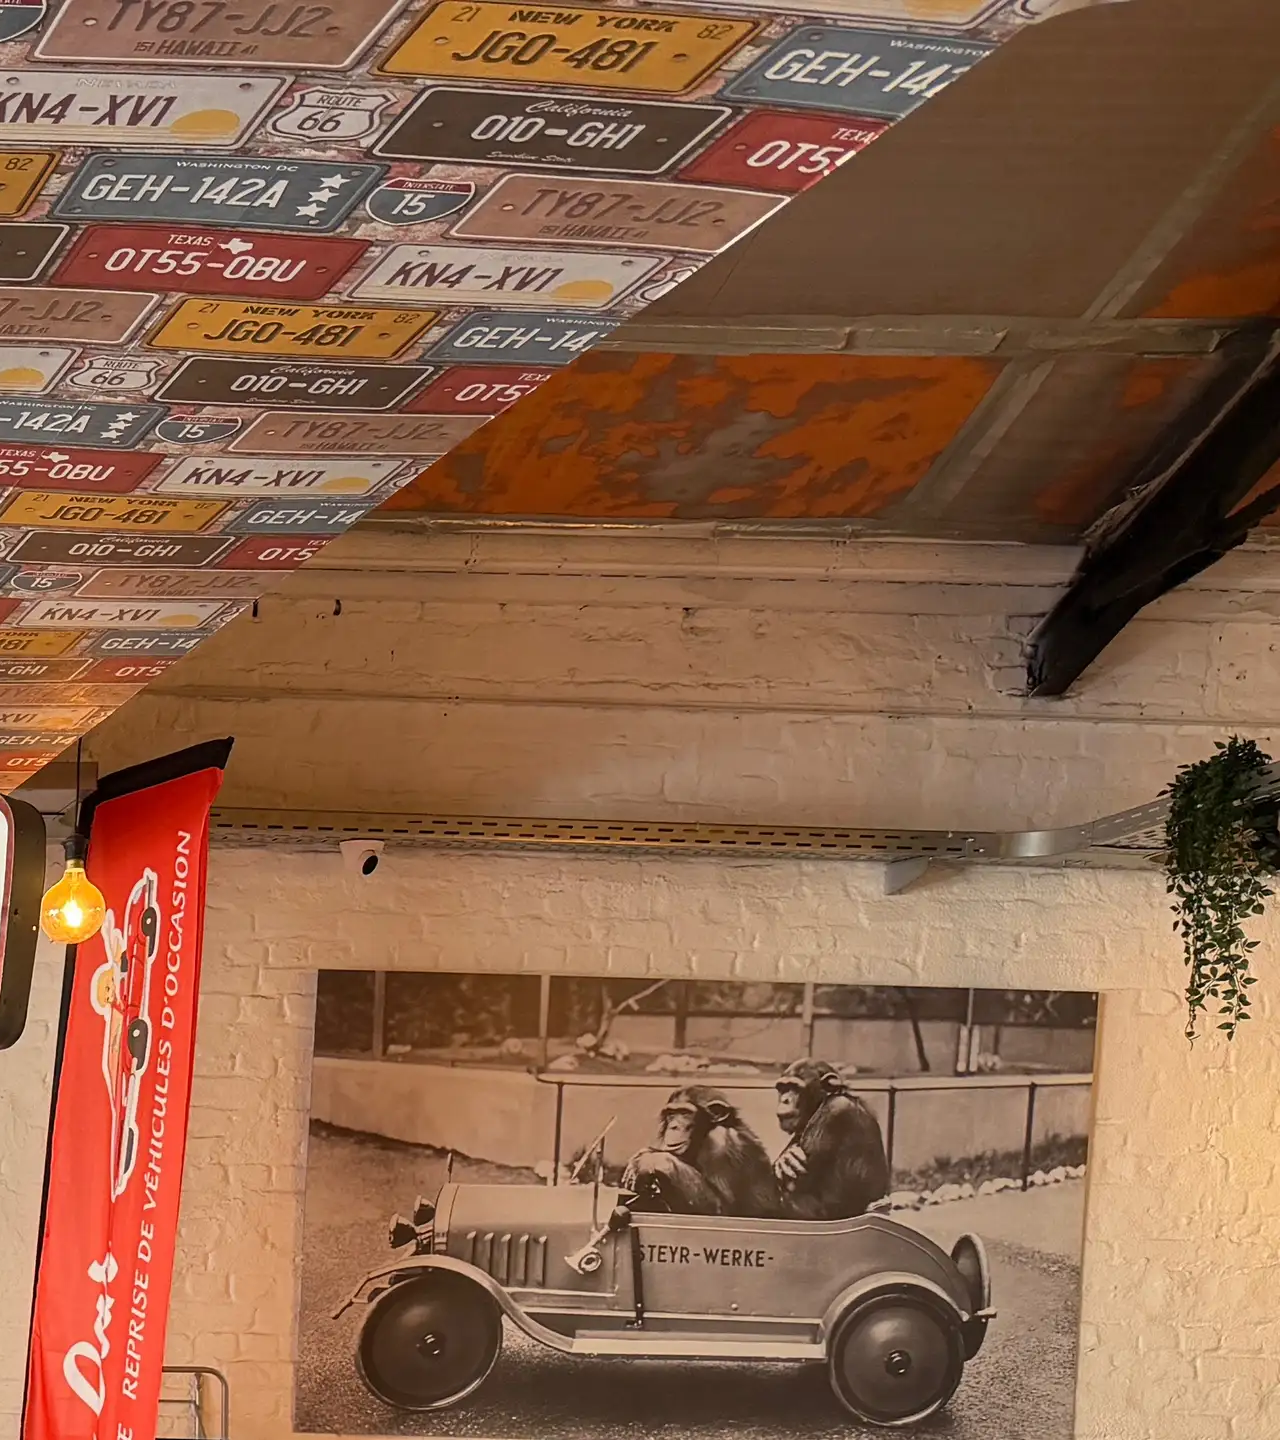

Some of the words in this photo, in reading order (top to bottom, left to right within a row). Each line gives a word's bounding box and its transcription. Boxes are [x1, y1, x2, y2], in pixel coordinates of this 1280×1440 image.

[451, 6, 481, 23] 21
[508, 9, 582, 26] NEW
[596, 14, 680, 33] YORK
[696, 24, 733, 41] 82
[158, 38, 241, 57] HAWAII
[312, 94, 369, 106] ROUTE
[525, 100, 632, 119] California
[293, 109, 351, 132] 66
[76, 171, 299, 207] GEH-142A
[387, 193, 438, 215] 15
[159, 830, 191, 1029] D'OCCASION
[144, 1038, 172, 1211] VÉHICULES
[138, 1220, 155, 1264] DE
[122, 1270, 149, 1400] REPRISE
